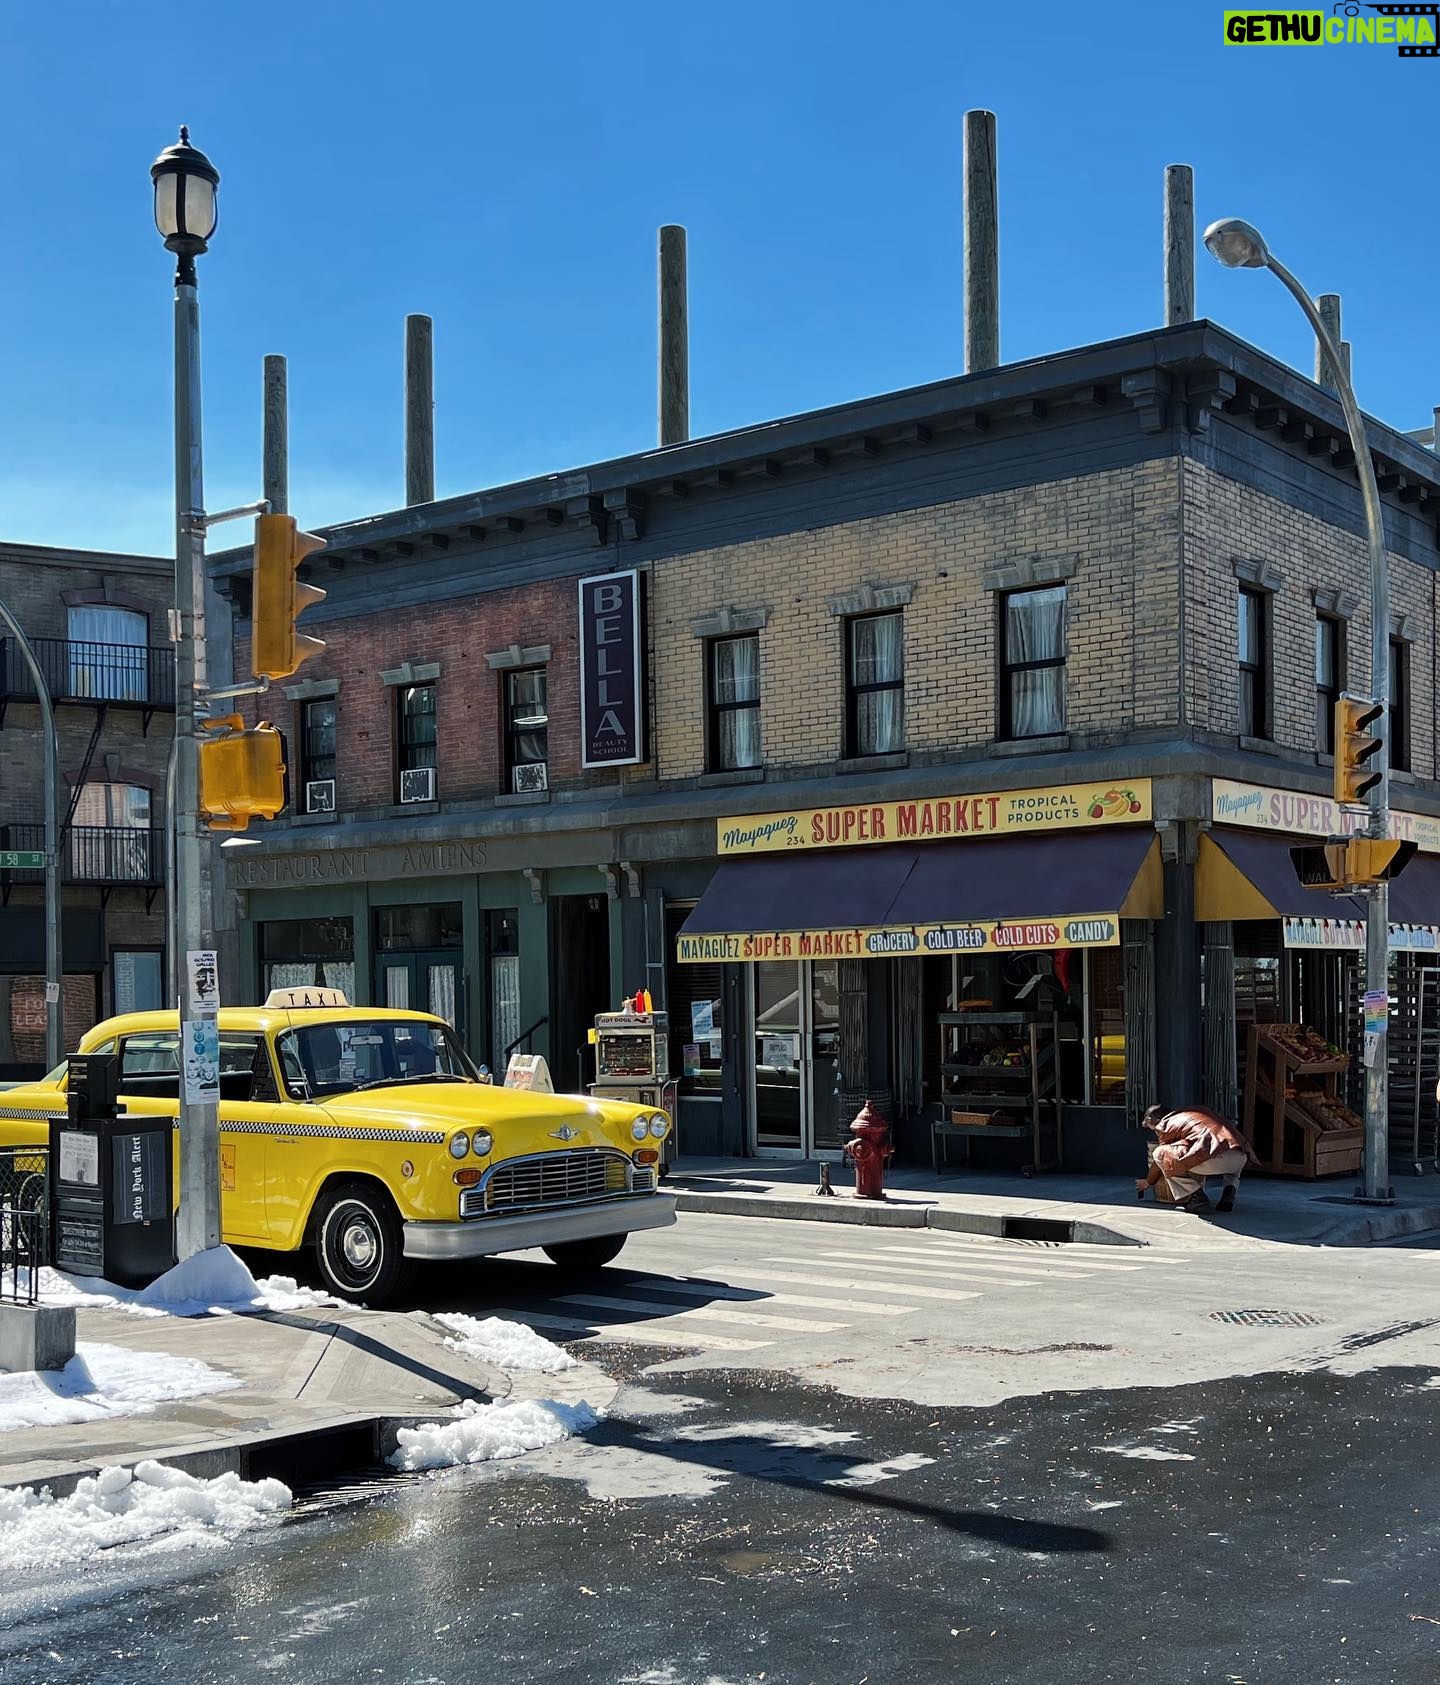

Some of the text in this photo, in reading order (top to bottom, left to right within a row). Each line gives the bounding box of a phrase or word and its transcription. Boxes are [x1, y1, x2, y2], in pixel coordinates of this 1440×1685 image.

[594, 584, 625, 738] BELLA
[592, 739, 628, 748] BEAUTY
[592, 746, 629, 755] SCHOOL
[1010, 795, 1077, 809] TROPICAL
[811, 797, 1001, 843] SUPER MARKET
[1008, 808, 1079, 823] PRODUCTS
[1256, 814, 1268, 825] 234
[1270, 793, 1334, 833] SUPER
[723, 816, 798, 848] Mayaguez
[786, 835, 805, 846] 234
[7, 853, 19, 866] 58
[234, 842, 488, 883] RESTAURANT AMIENS
[928, 928, 984, 949] COLD BEER
[995, 924, 1056, 945] COLD CUTS
[1069, 920, 1109, 942] CANDY
[681, 932, 915, 959] MAYAGUEZ SUPER MARKET GROCERY
[288, 993, 338, 1006] TAXI
[131, 1136, 144, 1220] New York Alert
